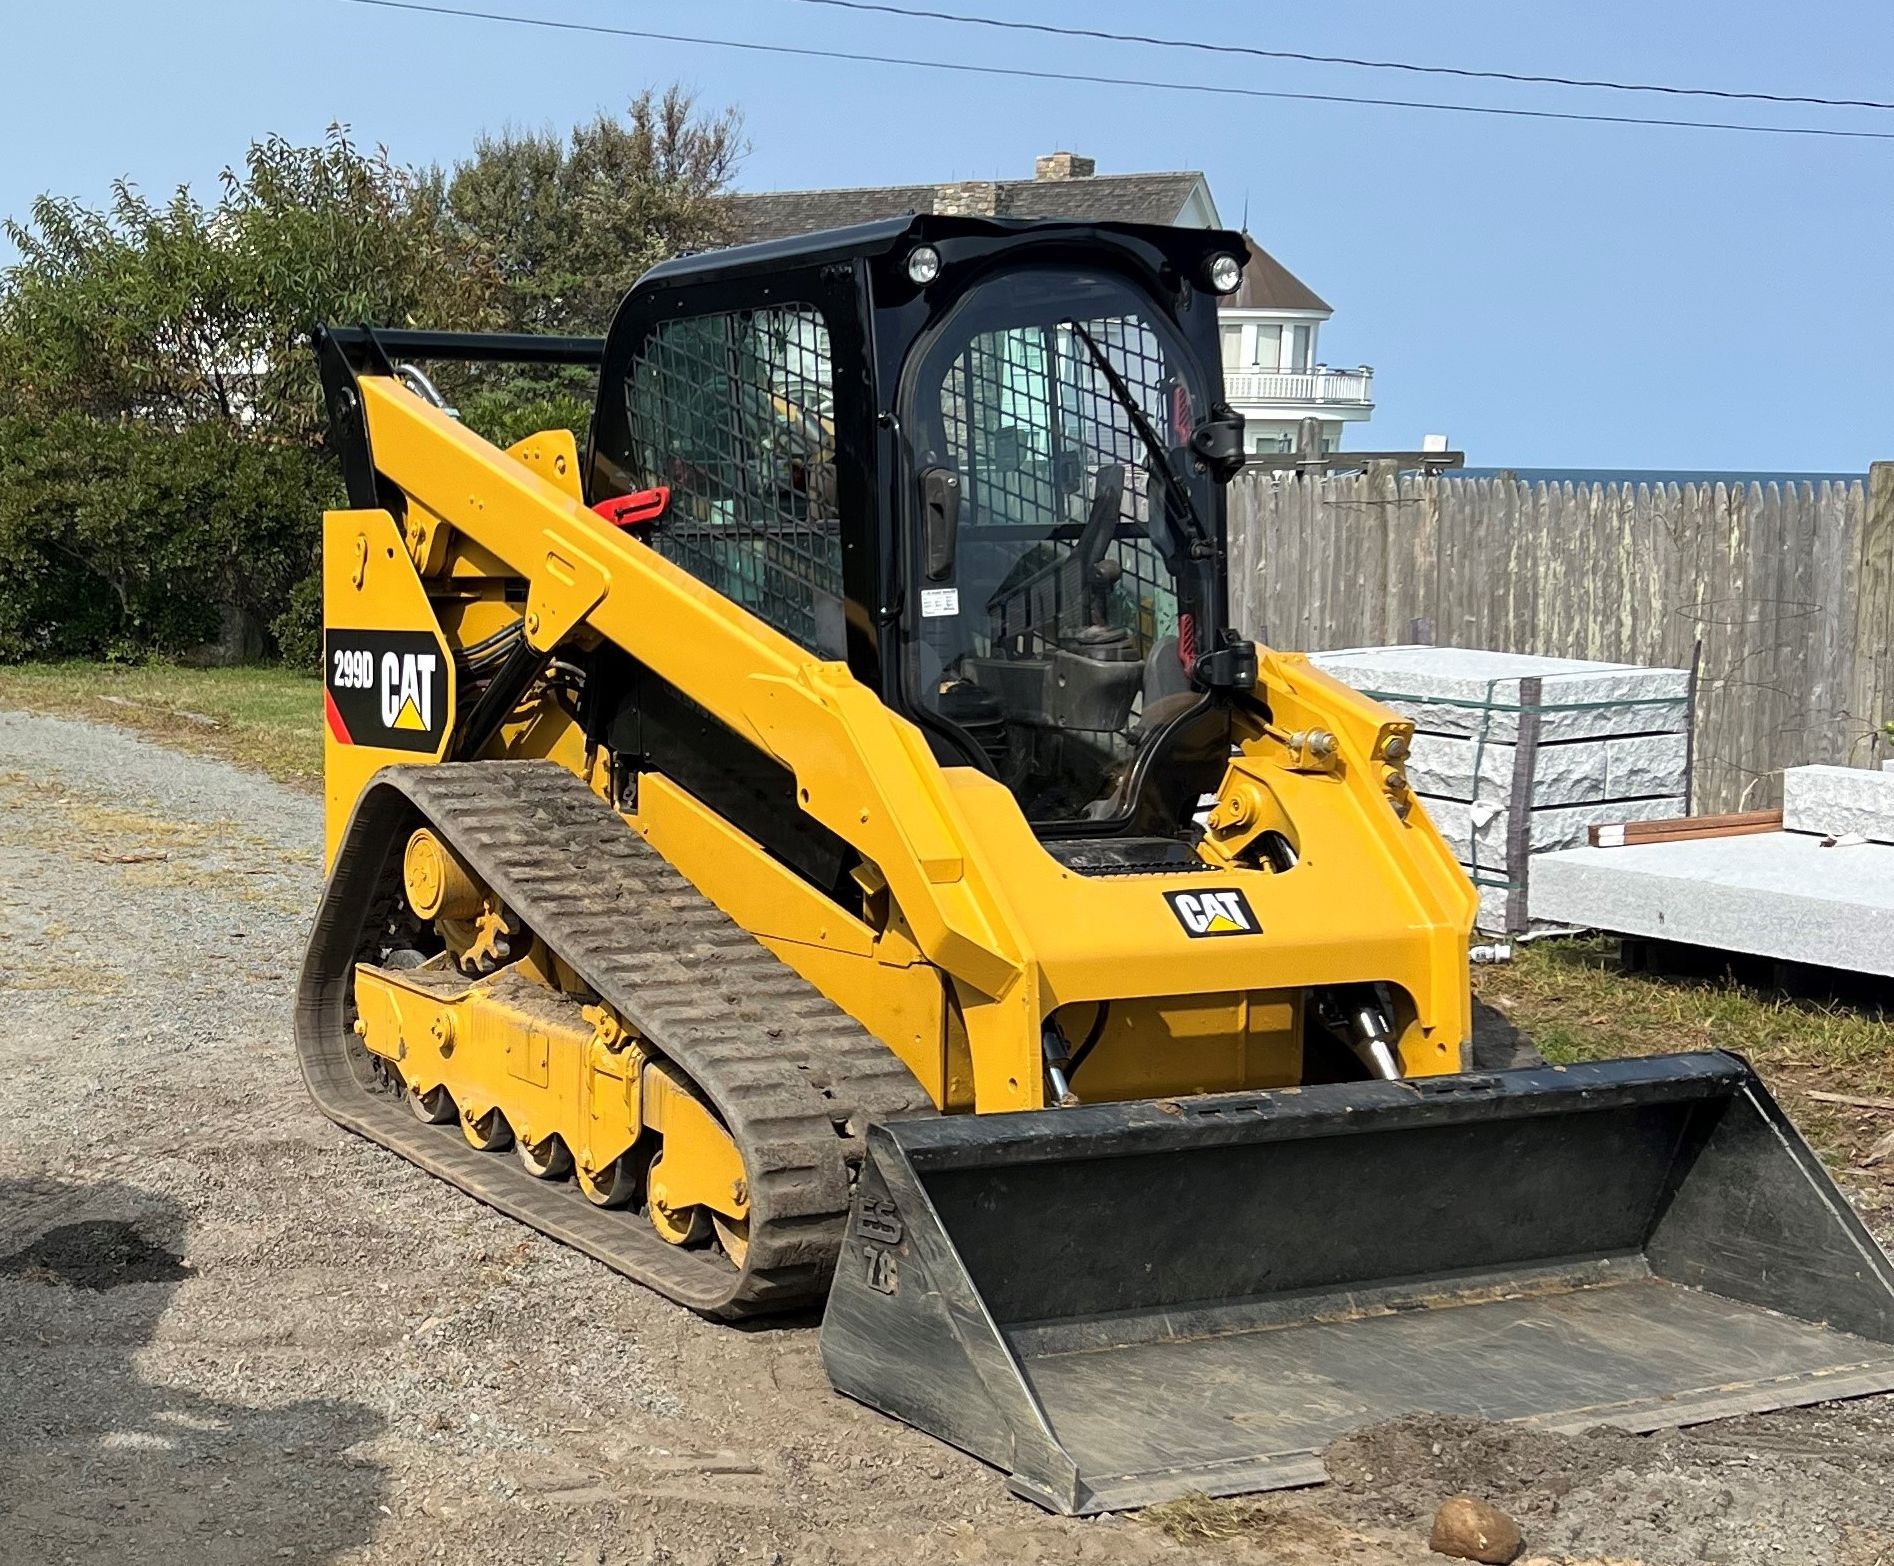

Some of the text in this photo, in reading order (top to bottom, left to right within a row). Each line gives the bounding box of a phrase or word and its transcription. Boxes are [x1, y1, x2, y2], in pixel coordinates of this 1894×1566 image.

[334, 650, 436, 731] 299D CAT
[1175, 892, 1251, 932] CAT
[863, 1246, 898, 1295] 78
